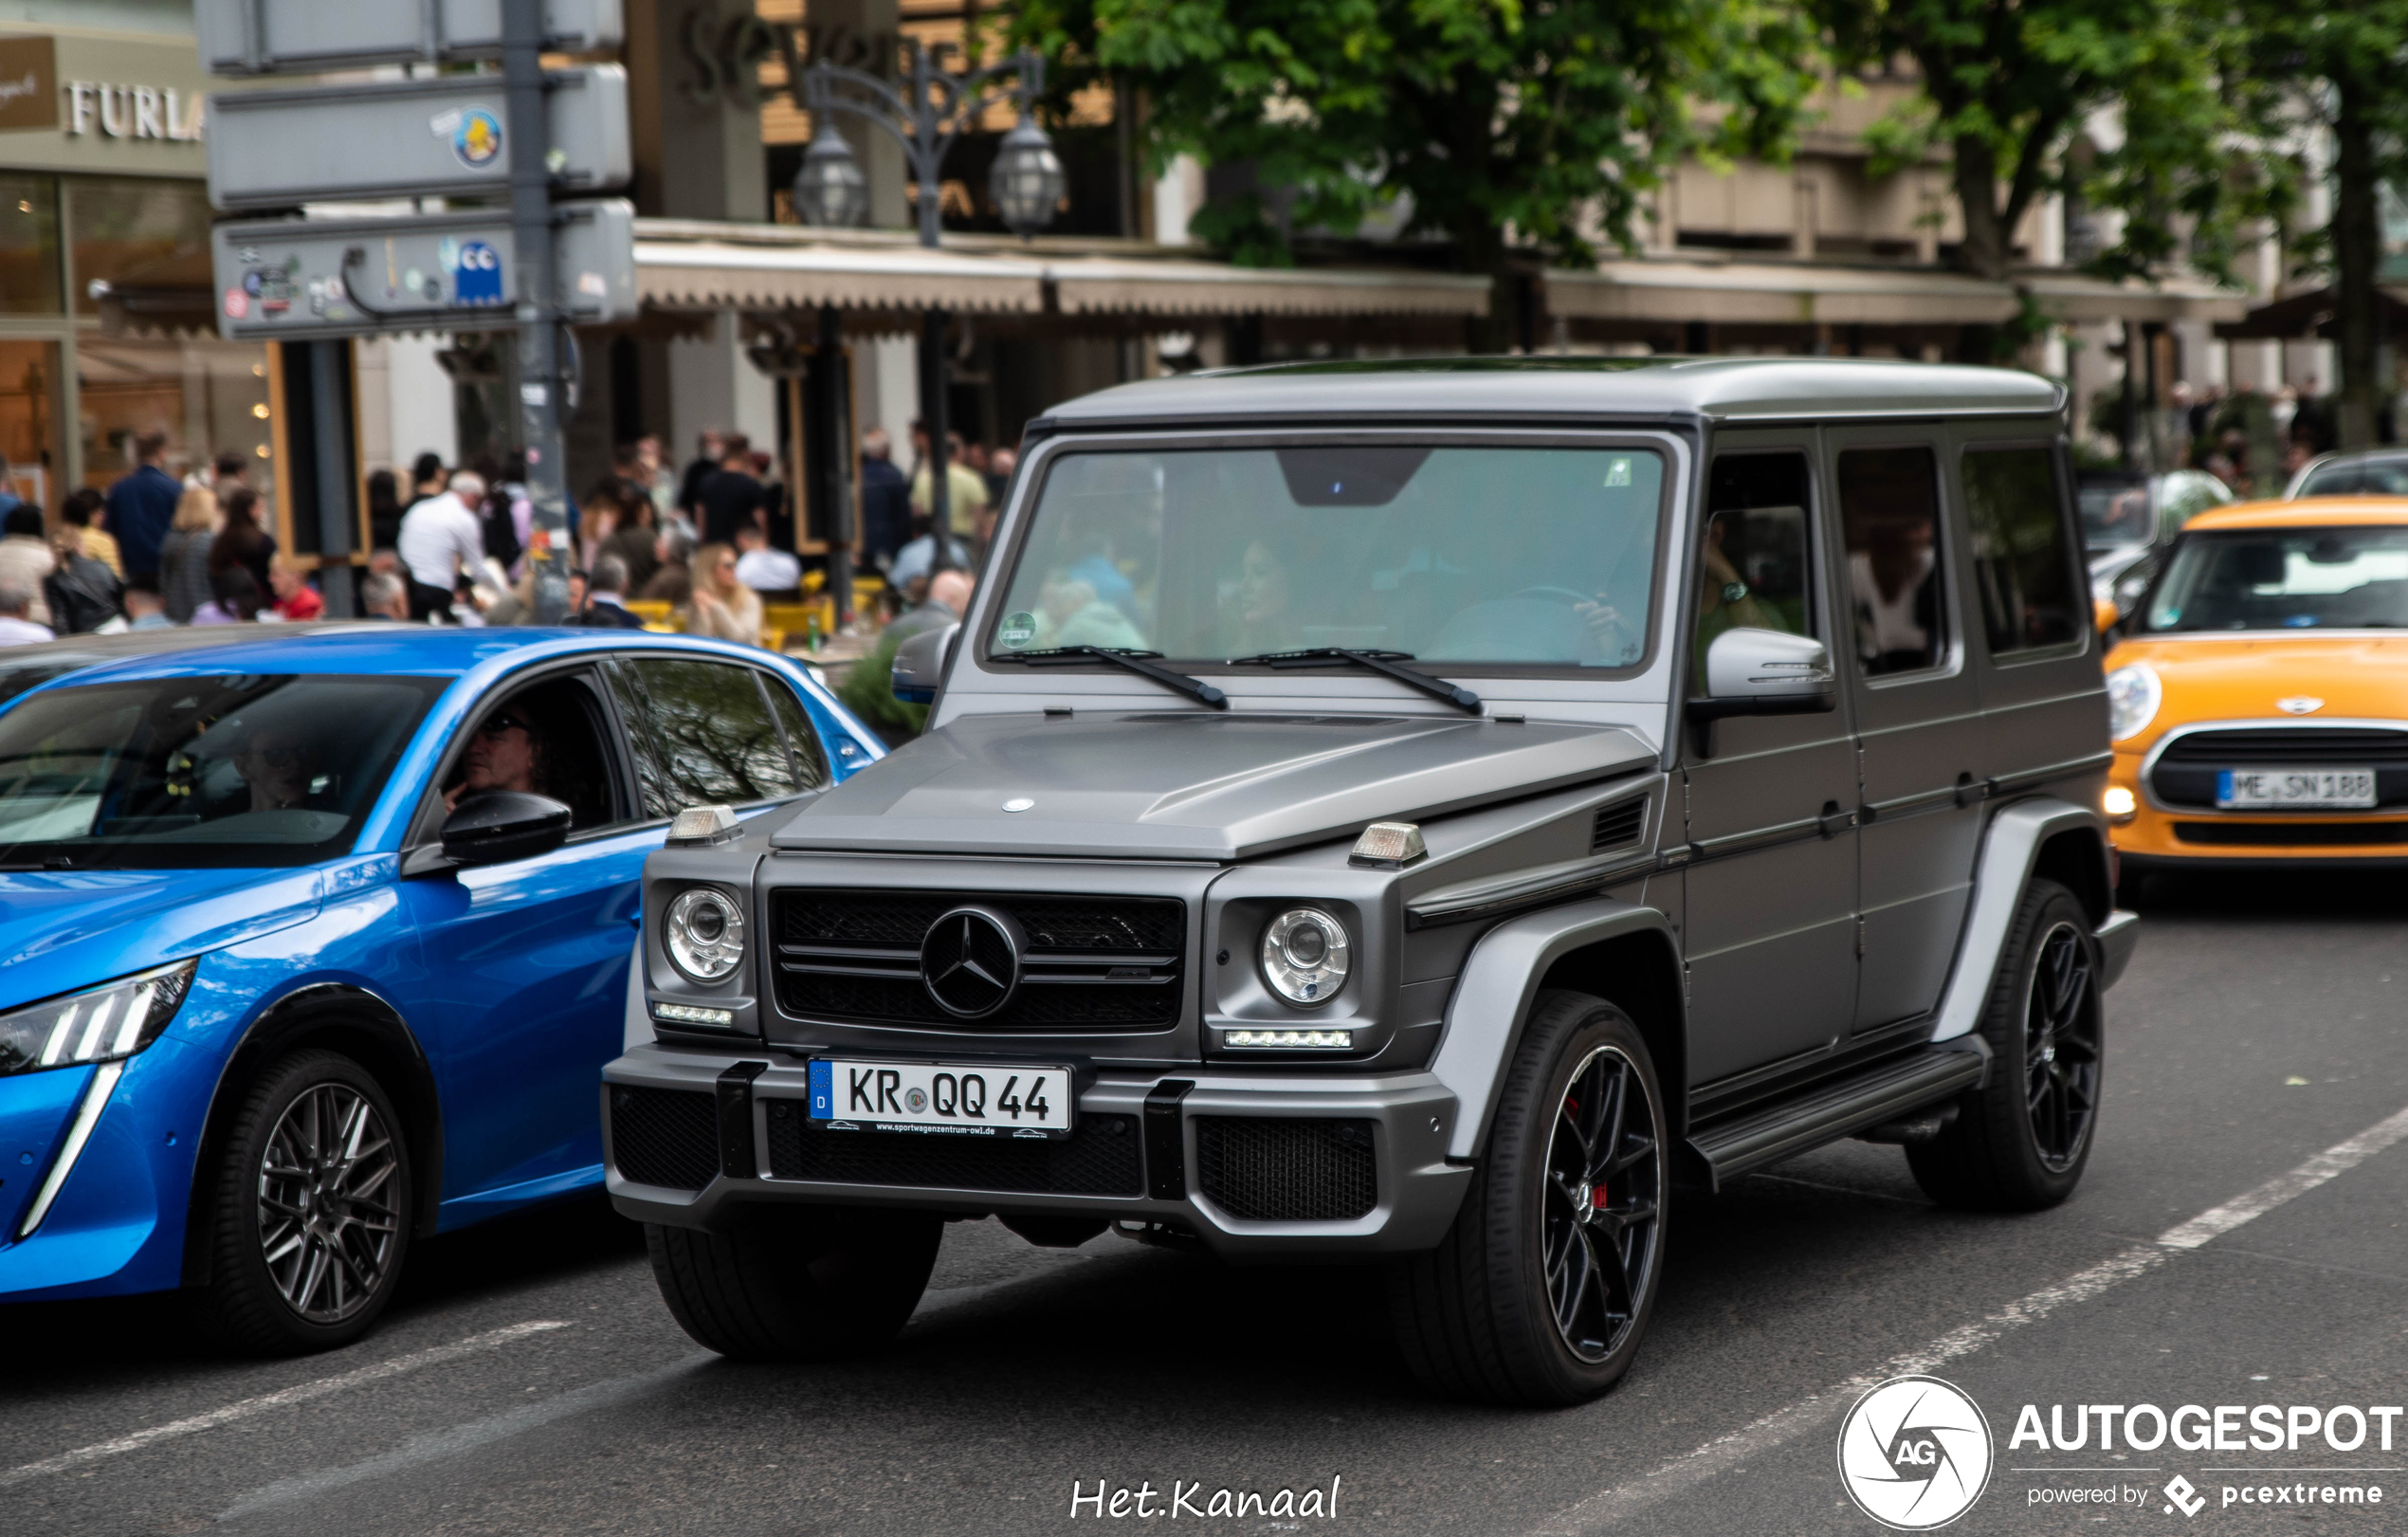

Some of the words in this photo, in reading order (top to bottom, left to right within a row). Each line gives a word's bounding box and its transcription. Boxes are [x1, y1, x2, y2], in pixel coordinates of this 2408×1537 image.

[2236, 776, 2266, 798] ME
[2286, 776, 2319, 797] SN
[816, 1096, 826, 1108] D
[849, 1068, 903, 1114] KR
[932, 1072, 986, 1118] QQ
[997, 1075, 1049, 1121] 44
[876, 1123, 994, 1136] www.sportwagenzentrum-owl.de
